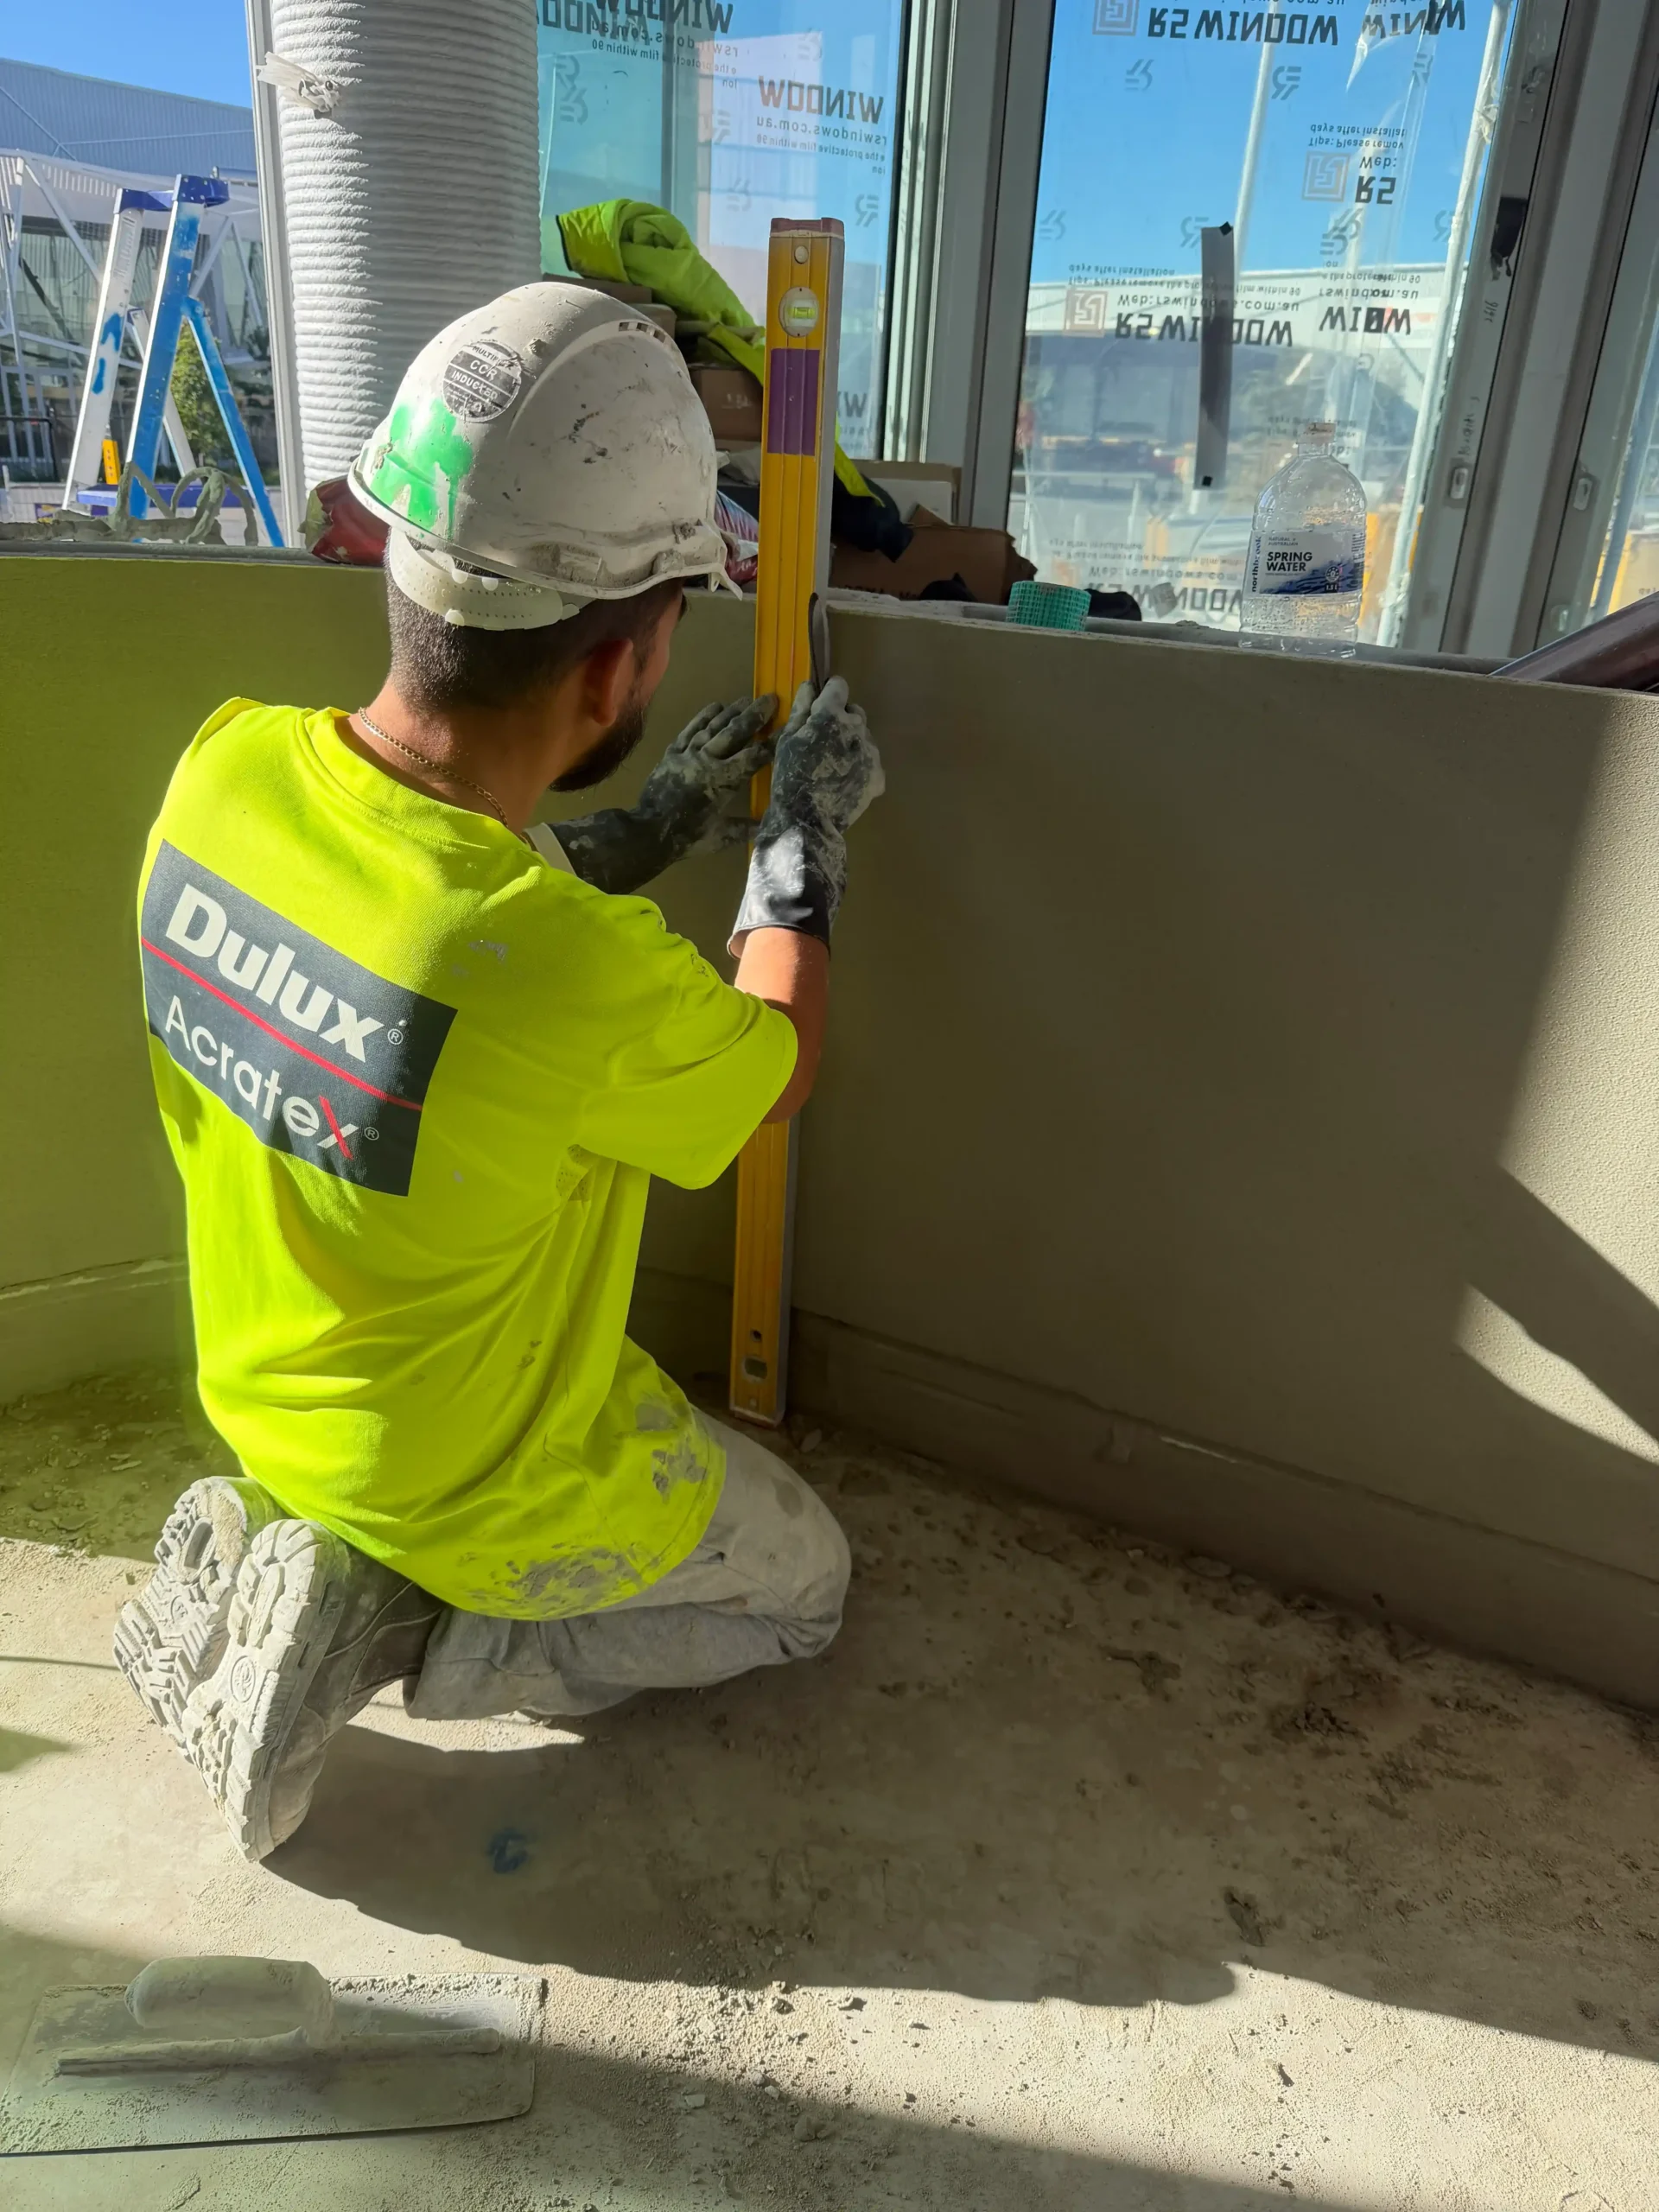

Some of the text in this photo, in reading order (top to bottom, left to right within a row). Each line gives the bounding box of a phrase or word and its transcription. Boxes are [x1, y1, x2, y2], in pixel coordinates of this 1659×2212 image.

[1266, 562, 1306, 572] WATER
[1267, 551, 1313, 563] SPRING
[165, 883, 385, 1063] Dulux
[164, 995, 359, 1160] Acratex
